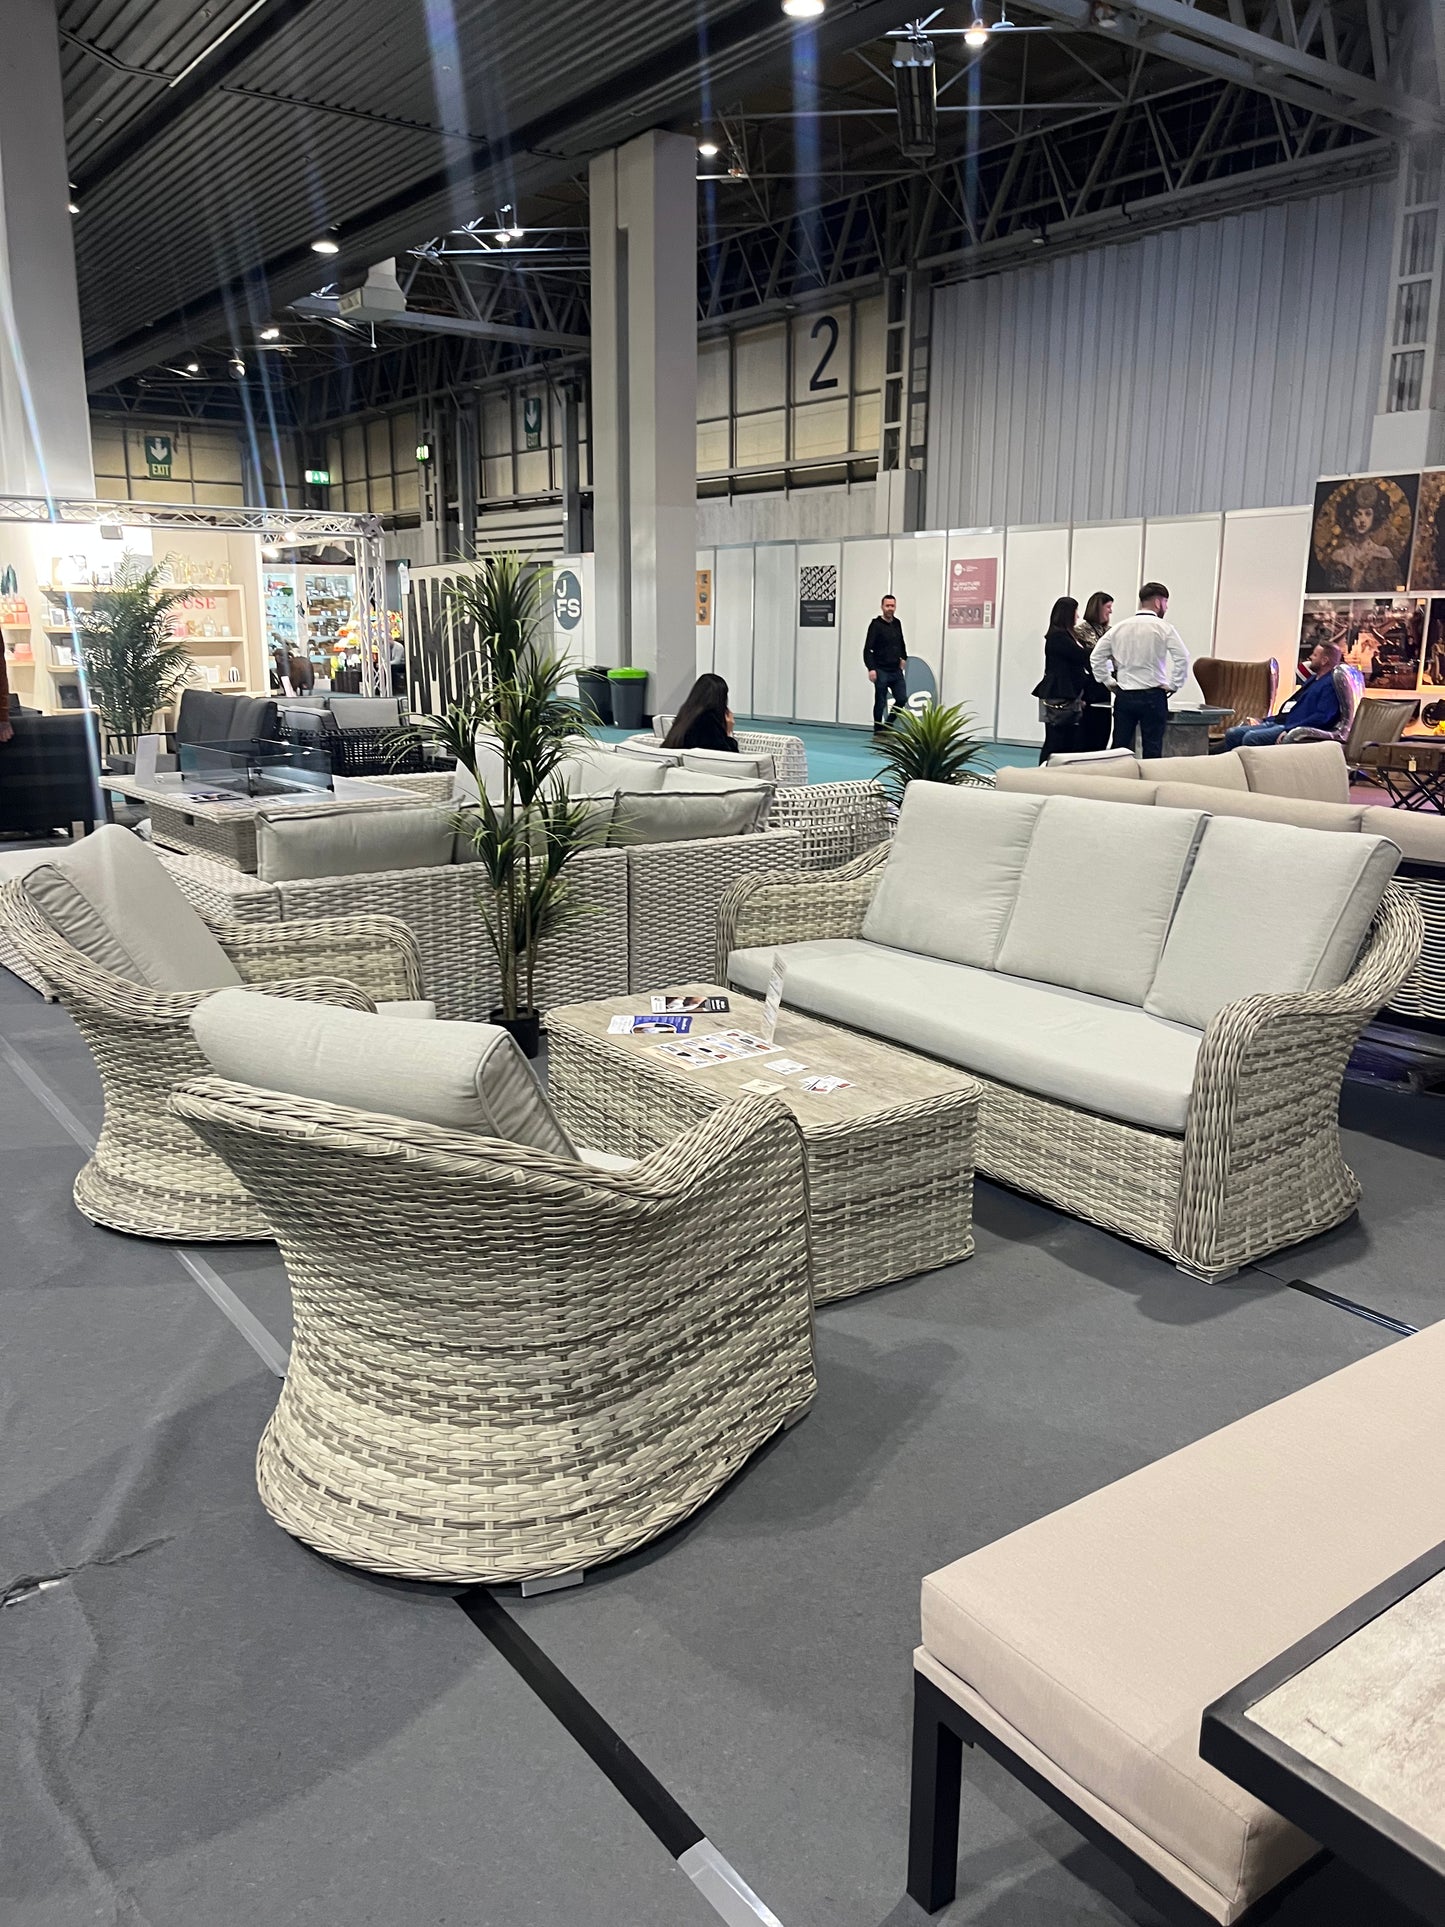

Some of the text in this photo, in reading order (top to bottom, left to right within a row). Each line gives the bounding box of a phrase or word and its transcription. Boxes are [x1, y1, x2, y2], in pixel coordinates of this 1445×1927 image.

[810, 315, 838, 391] 2
[152, 464, 169, 476] EXIT
[556, 579, 567, 598] J
[556, 598, 581, 618] FS
